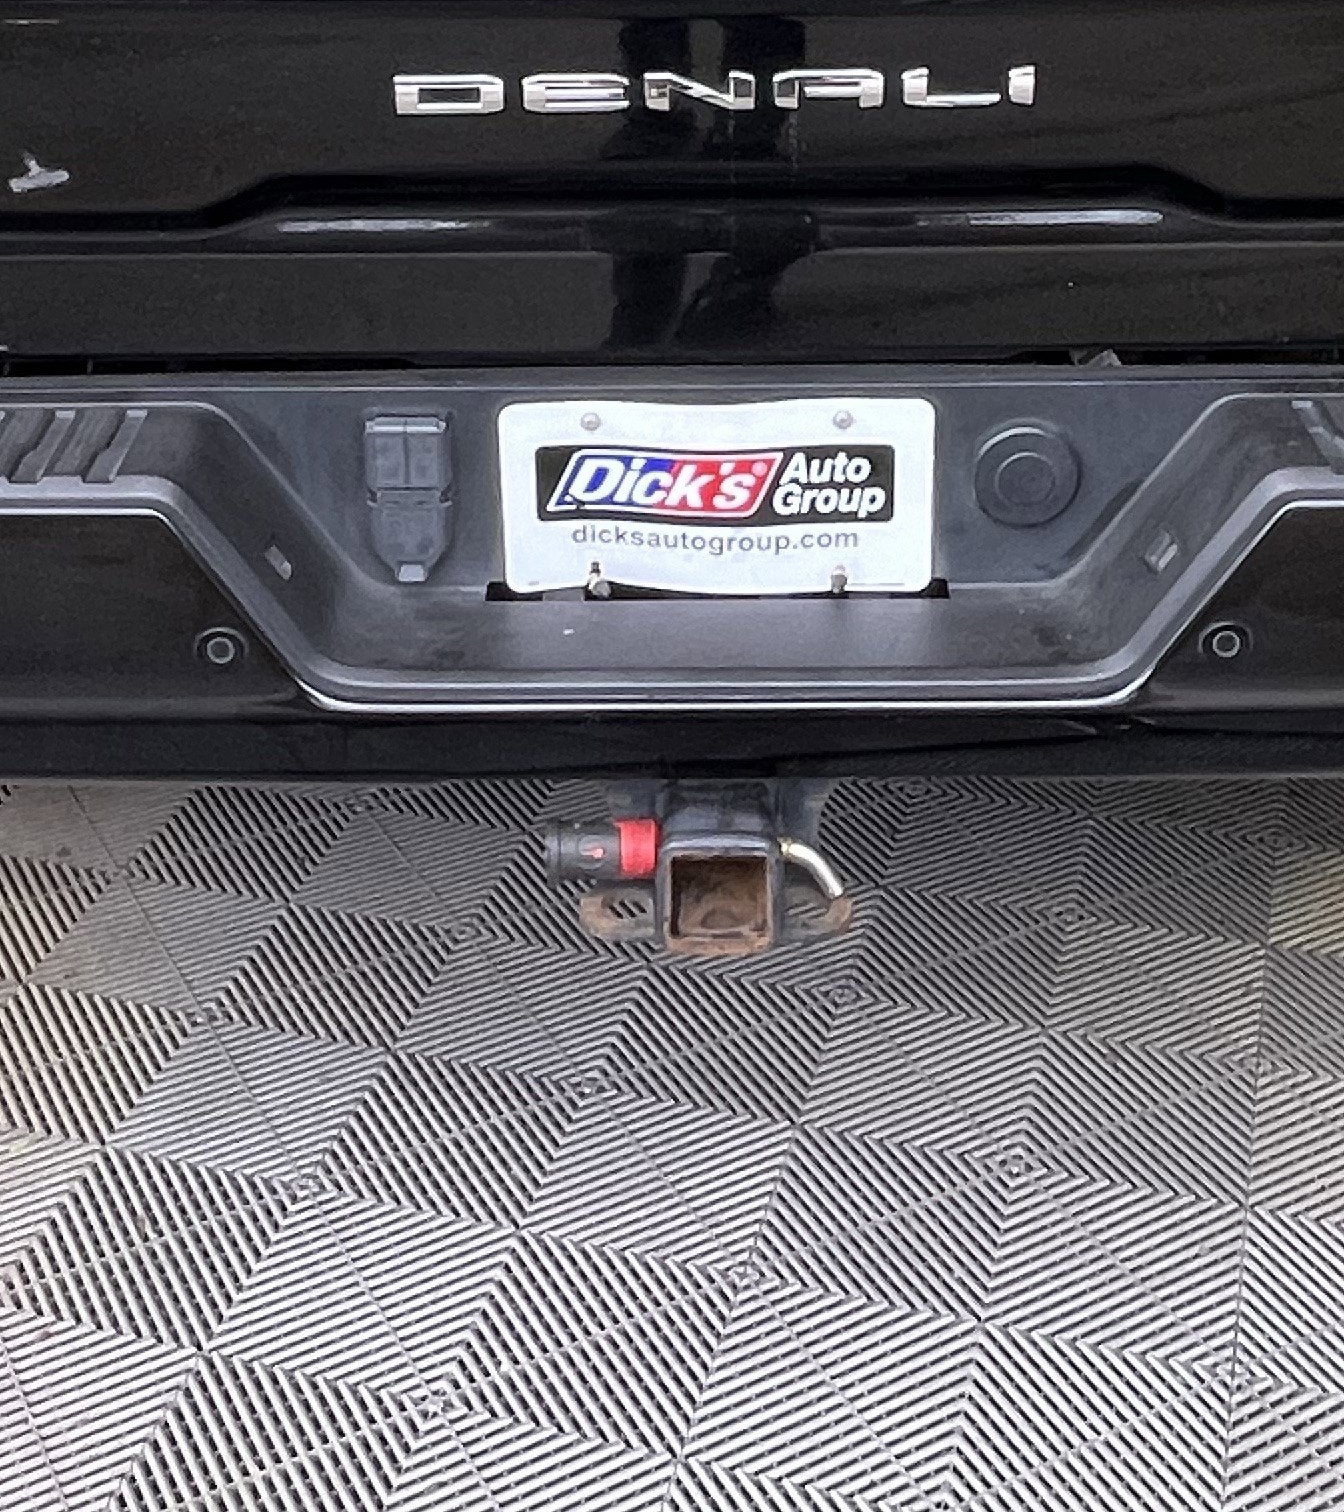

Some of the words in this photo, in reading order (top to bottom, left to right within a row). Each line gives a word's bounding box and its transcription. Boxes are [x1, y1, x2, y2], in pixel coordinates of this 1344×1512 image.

[392, 64, 1036, 115] DENALI
[568, 457, 757, 509] Dick's
[778, 452, 872, 485] Auto
[771, 482, 887, 518] Group
[570, 524, 860, 556] dicksautogroup.com
